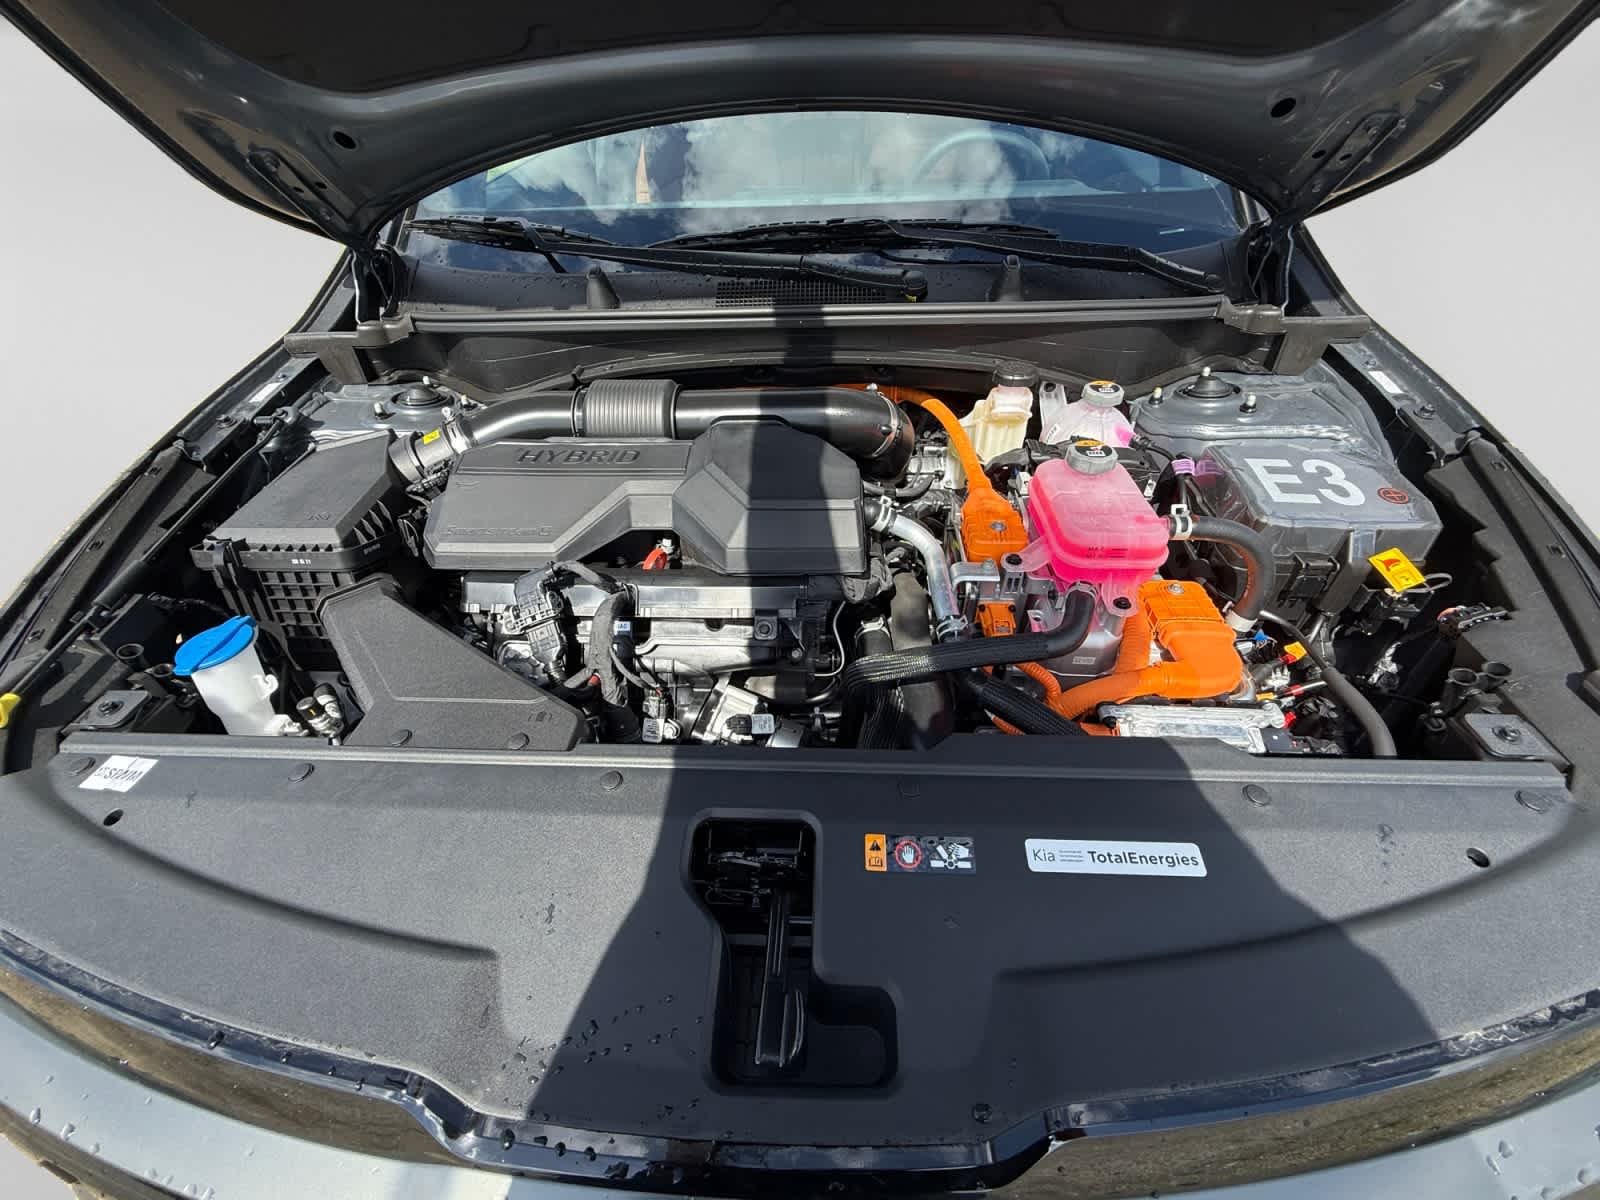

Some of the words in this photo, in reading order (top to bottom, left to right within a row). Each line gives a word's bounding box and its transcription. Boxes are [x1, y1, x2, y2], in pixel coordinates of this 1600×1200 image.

[516, 448, 640, 465] HYBRID
[1243, 458, 1365, 505] E3
[1032, 848, 1056, 863] Kia
[1087, 850, 1199, 867] TotalEnergies
